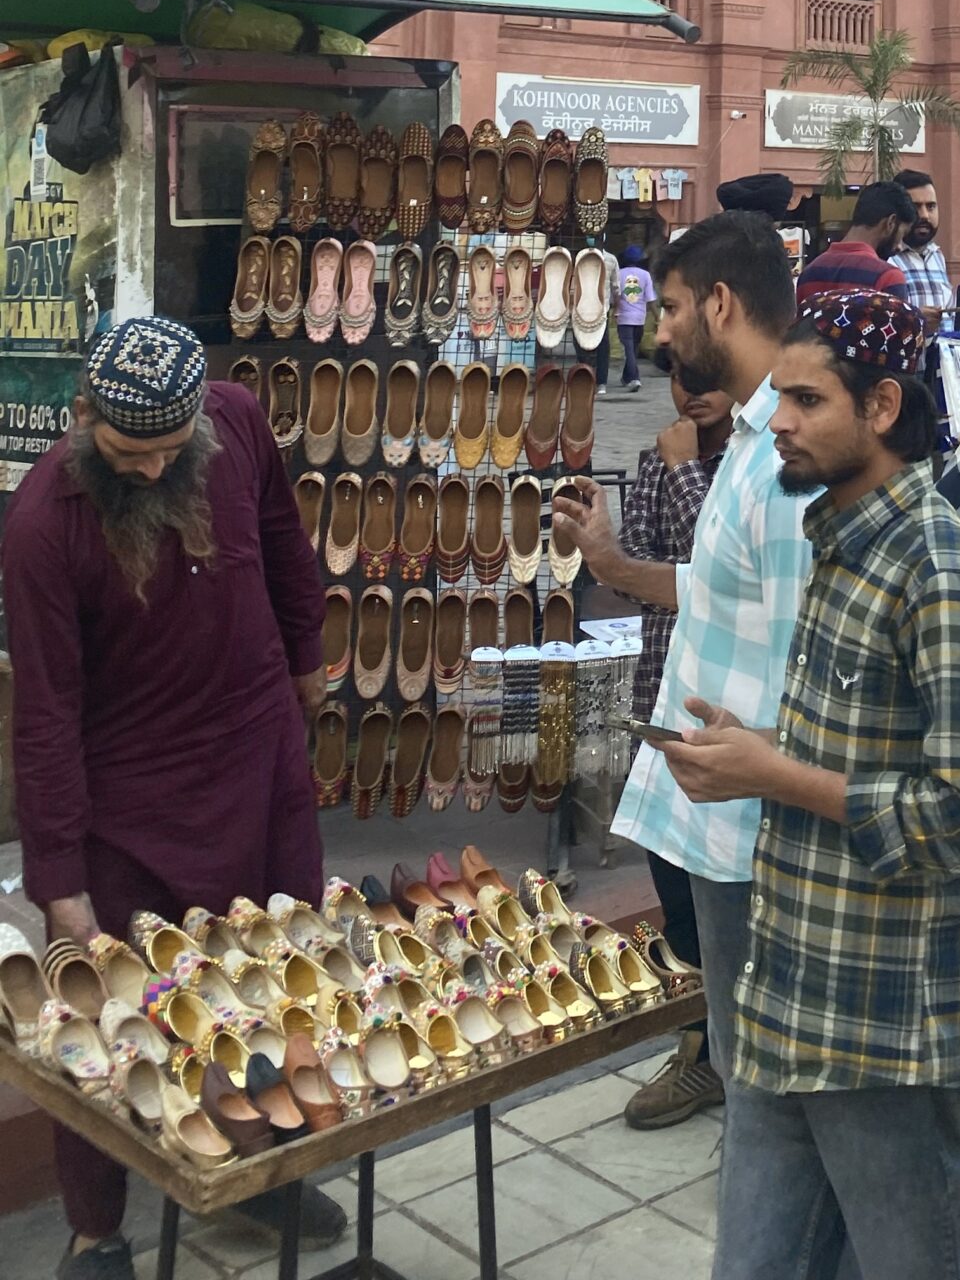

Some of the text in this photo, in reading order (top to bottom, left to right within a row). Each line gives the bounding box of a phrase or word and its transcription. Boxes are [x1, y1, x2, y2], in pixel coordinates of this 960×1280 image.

[512, 89, 679, 115] KOHINOOR AGENCIES
[12, 200, 78, 241] MATCH
[3, 235, 72, 299] DAY
[0, 300, 80, 339] MANIA
[7, 403, 27, 429] TO
[29, 405, 56, 431] 60%
[8, 436, 24, 451] TOP
